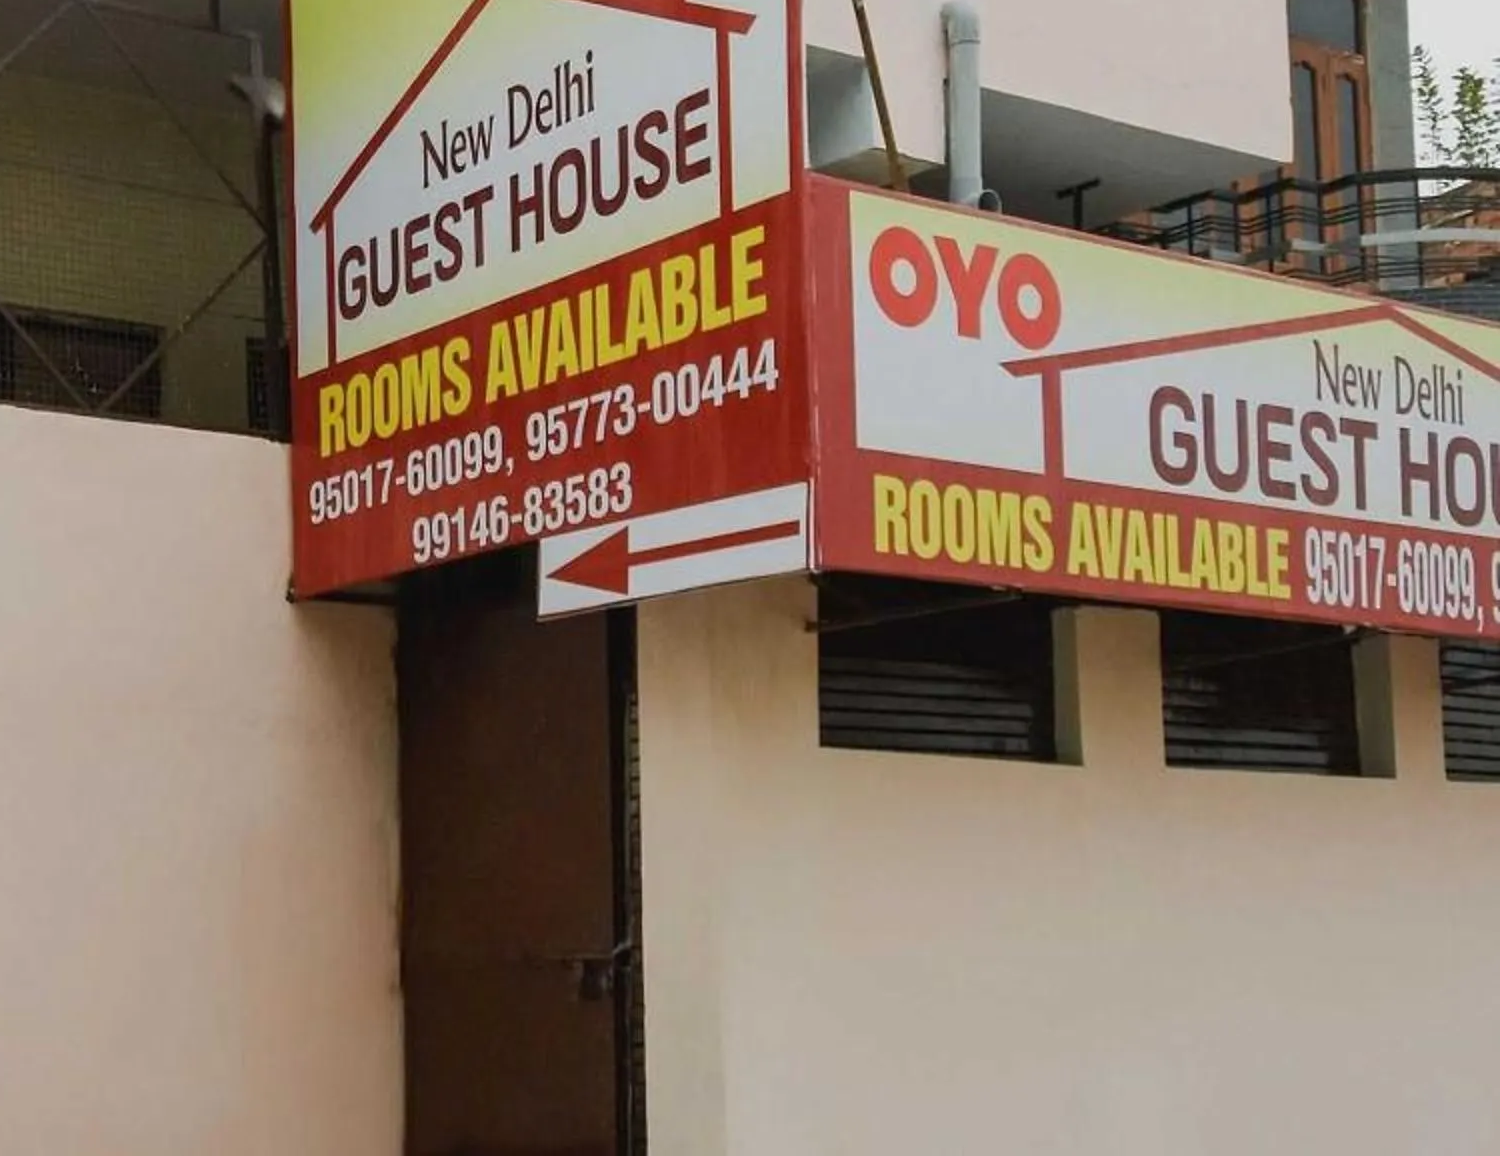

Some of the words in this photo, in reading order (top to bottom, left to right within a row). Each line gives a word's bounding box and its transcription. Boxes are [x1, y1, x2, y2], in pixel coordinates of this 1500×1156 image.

[419, 114, 496, 189] New
[507, 49, 596, 149] Delhi
[337, 185, 495, 321] GUEST
[509, 88, 713, 253] HOUSE
[319, 337, 471, 458] ROOMS
[485, 225, 768, 404] AVAILABLE
[869, 226, 1062, 351] OYO
[310, 425, 514, 524] 95017-60099,
[526, 338, 780, 460] 95773-00444
[1312, 339, 1382, 410] New
[1394, 356, 1464, 426] Delhi
[412, 462, 633, 563] 99146-83583
[1149, 385, 1379, 511] GUEST
[1399, 427, 1500, 527] HO
[873, 474, 1054, 572] ROOMS
[1067, 502, 1291, 599] AVAILABLE
[1305, 527, 1484, 633] 95017-60099,
